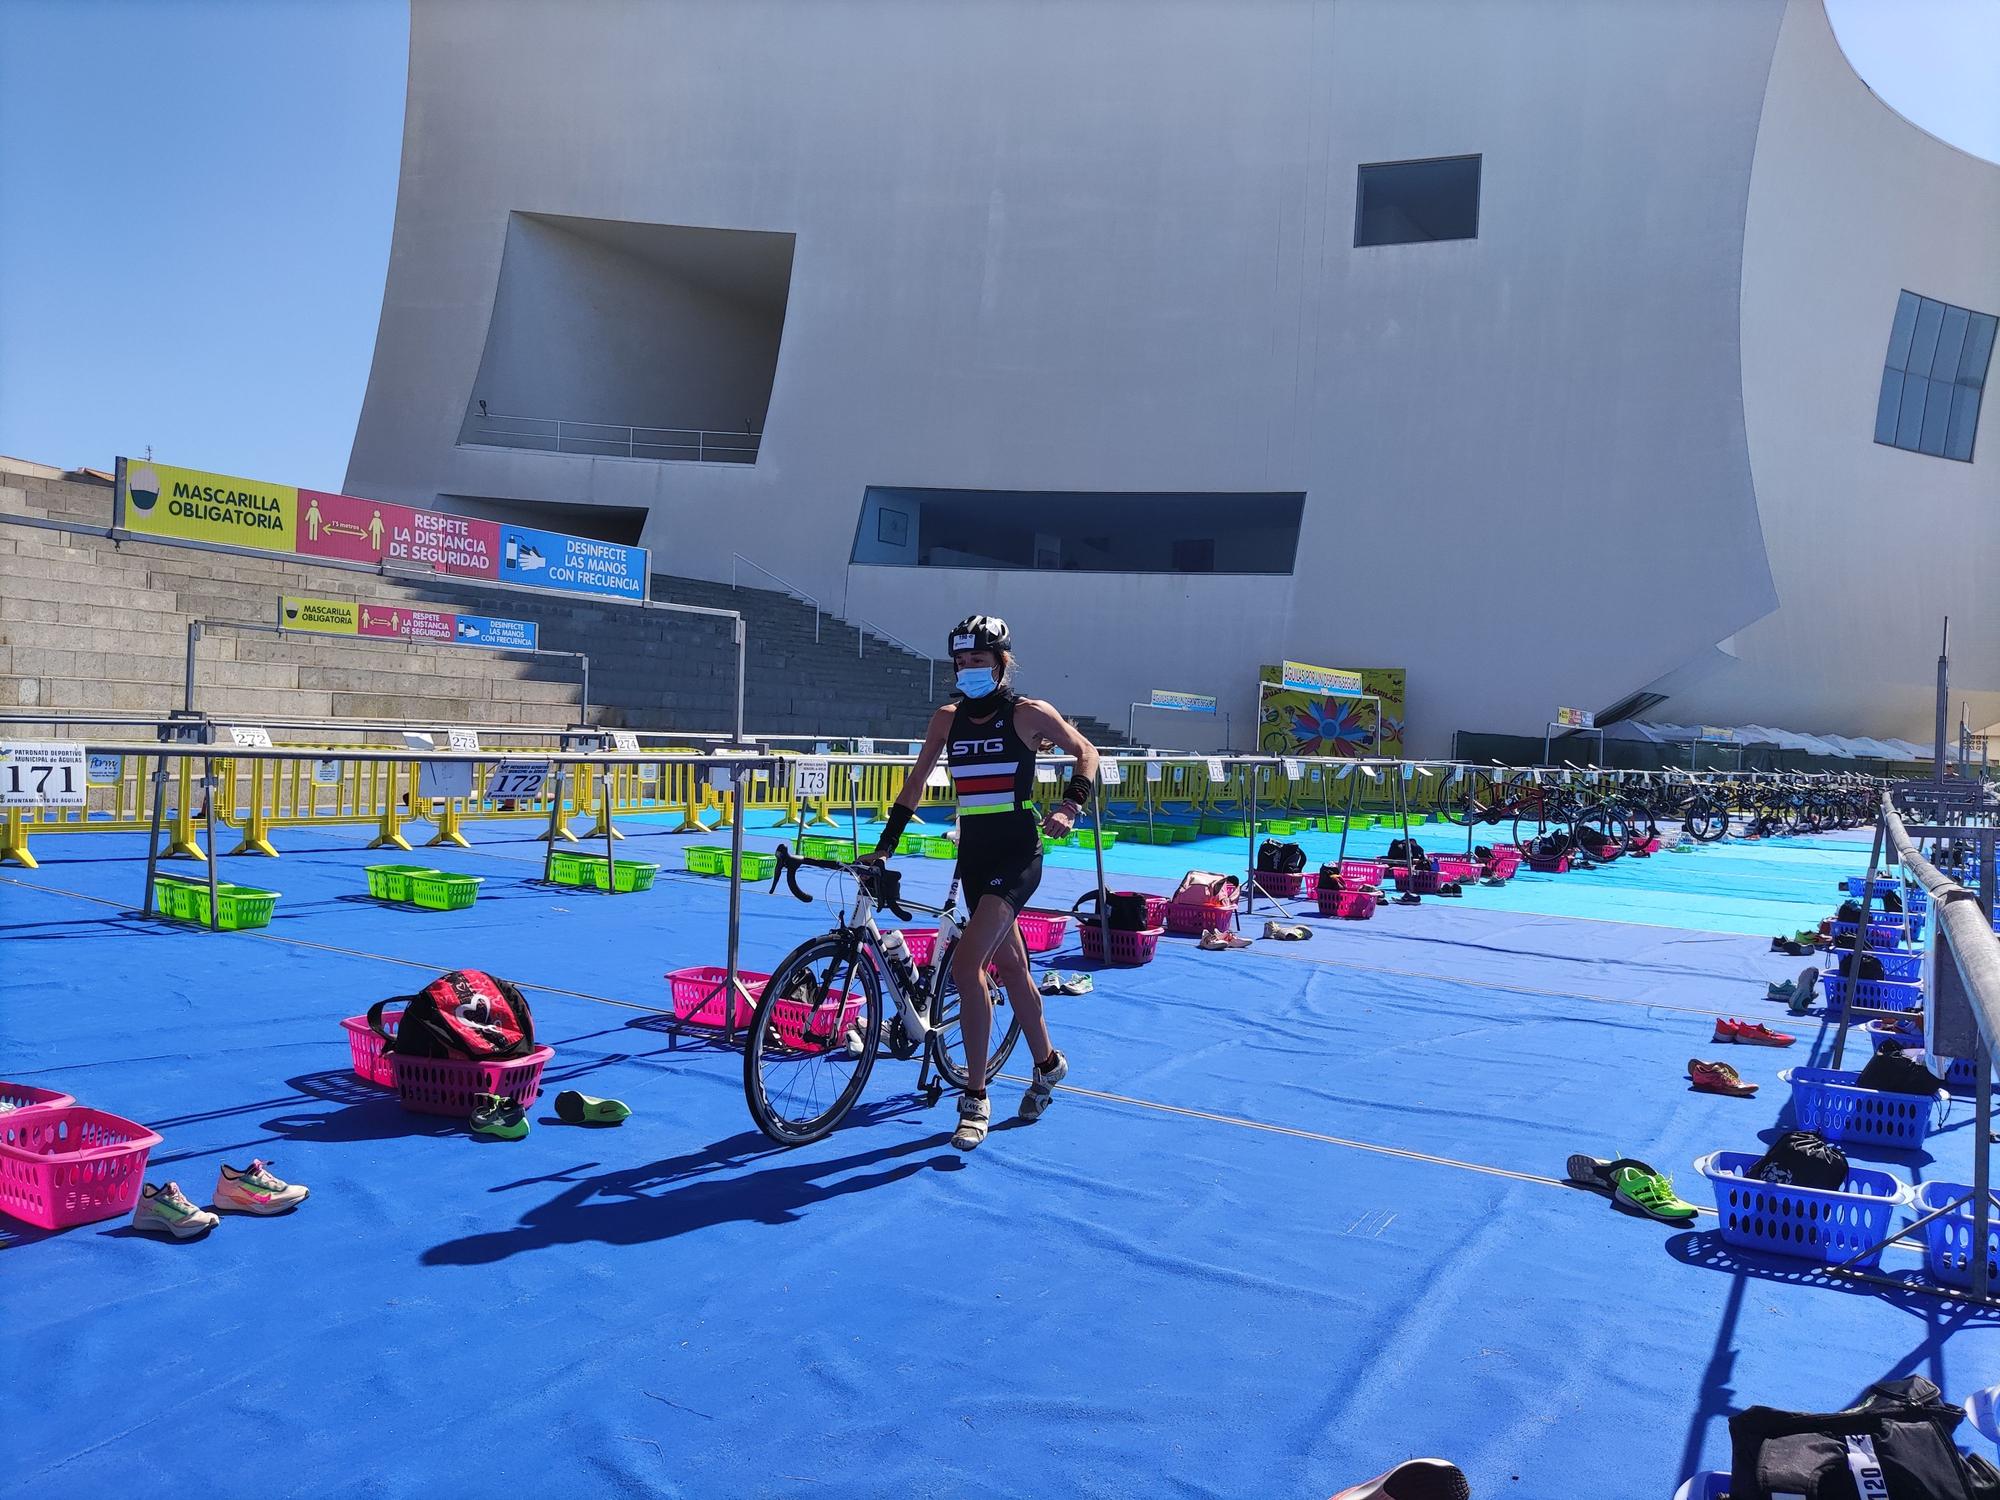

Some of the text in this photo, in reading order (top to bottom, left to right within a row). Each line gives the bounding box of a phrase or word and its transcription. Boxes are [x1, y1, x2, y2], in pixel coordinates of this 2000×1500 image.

[173, 481, 281, 513] MASCARILLA
[168, 500, 283, 531] OBLIGATORIA
[414, 513, 468, 536] RESPETE
[394, 526, 487, 554] LA DISTANCIA
[389, 542, 489, 569] DE SEGURIDAD
[567, 540, 627, 562] DESINFECTE
[565, 554, 627, 575] LAS MANOS
[549, 566, 640, 591] CON FRECUENCIA
[303, 605, 351, 616] MASCARILLA
[412, 611, 440, 622] RESPETE
[301, 613, 352, 625] OBLIGATORIA
[403, 619, 449, 630] LA DISTANCIA
[490, 621, 524, 631] DESINFECTE
[401, 626, 450, 638] DE SEGURIDAD
[489, 628, 524, 638] LAS MANOS
[481, 634, 532, 645] CON FRECUENCIA
[236, 733, 266, 744] 272
[452, 736, 477, 749] 273
[618, 738, 637, 750] 274
[14, 748, 83, 757] PATRONATO DEPORTIVO
[952, 738, 1004, 756] STG
[6, 765, 77, 793] 171
[1103, 766, 1118, 780] 175
[493, 775, 542, 792] 172
[799, 772, 825, 789] 173
